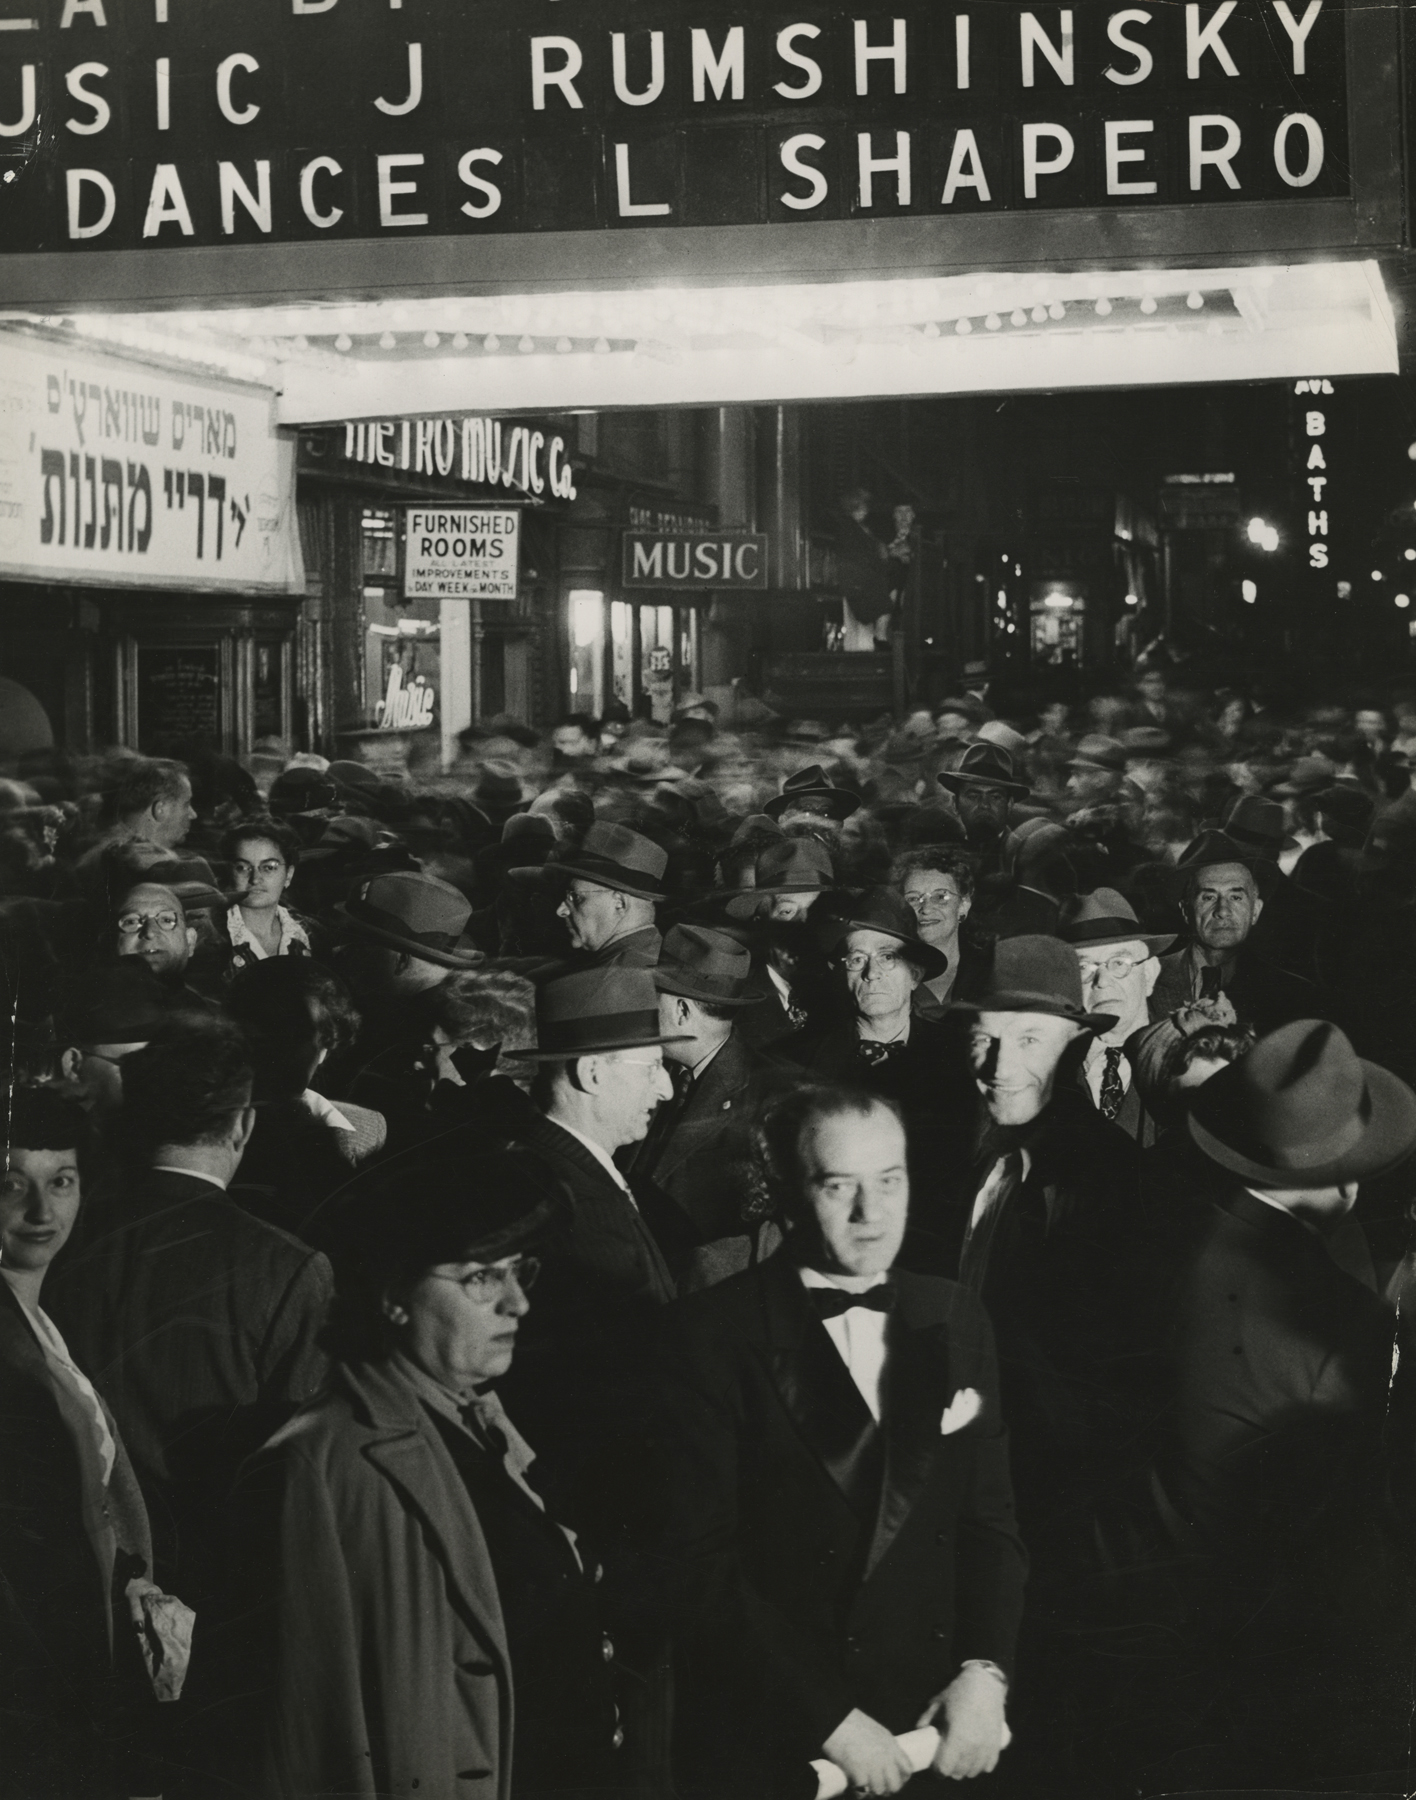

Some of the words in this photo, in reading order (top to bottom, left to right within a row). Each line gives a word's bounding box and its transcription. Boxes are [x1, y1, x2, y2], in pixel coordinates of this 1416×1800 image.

[374, 42, 423, 116] J
[530, 0, 1323, 110] RUMSHINSKY
[66, 147, 503, 239] DANCES
[615, 143, 671, 217] L
[779, 113, 1324, 210] SHAPERO
[460, 416, 545, 494] MUSIC
[1305, 410, 1329, 569] BATHS
[411, 513, 516, 534] FURNISHED
[419, 537, 504, 559] ROOMS
[632, 540, 759, 580] MUSIC
[411, 568, 509, 580] IMPROVEMENTS
[452, 560, 494, 568] LATEST
[414, 581, 435, 593] DAY
[437, 582, 469, 594] WEEK
[479, 582, 513, 595] MONTH
